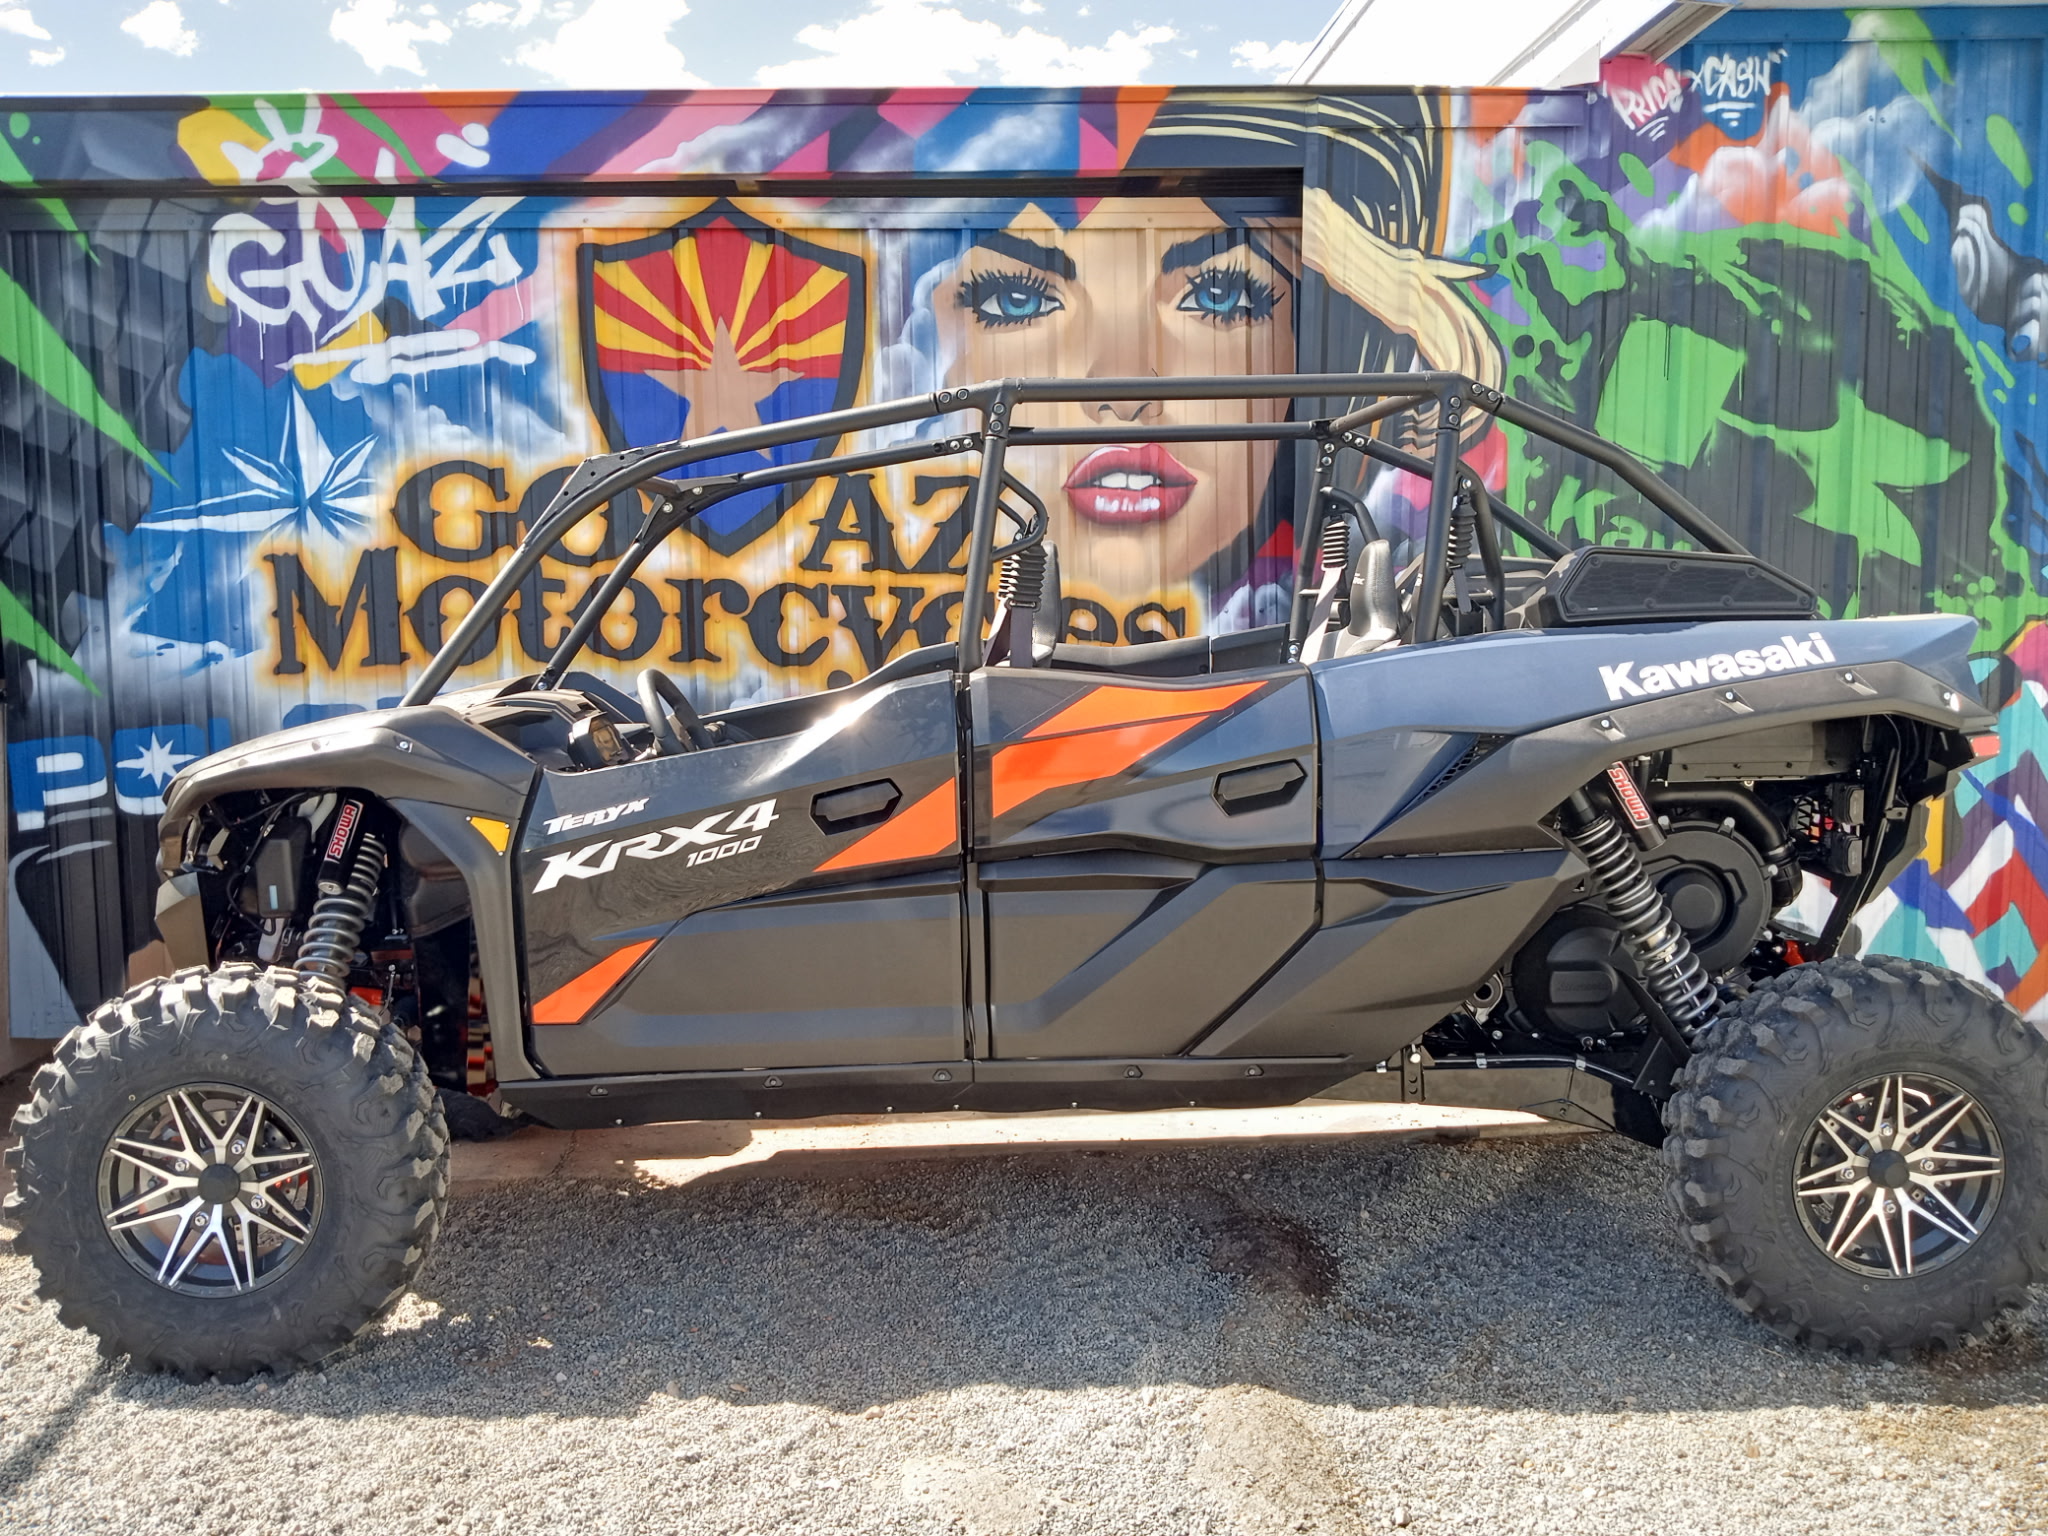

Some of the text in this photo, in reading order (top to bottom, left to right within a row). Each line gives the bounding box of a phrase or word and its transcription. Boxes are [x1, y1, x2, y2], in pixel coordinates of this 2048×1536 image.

[800, 473, 999, 574] AZ
[1598, 632, 1836, 701] Kawasaki
[1607, 767, 1650, 821] SHOWA
[328, 804, 357, 858] SHOWA
[686, 835, 762, 868] 1000
